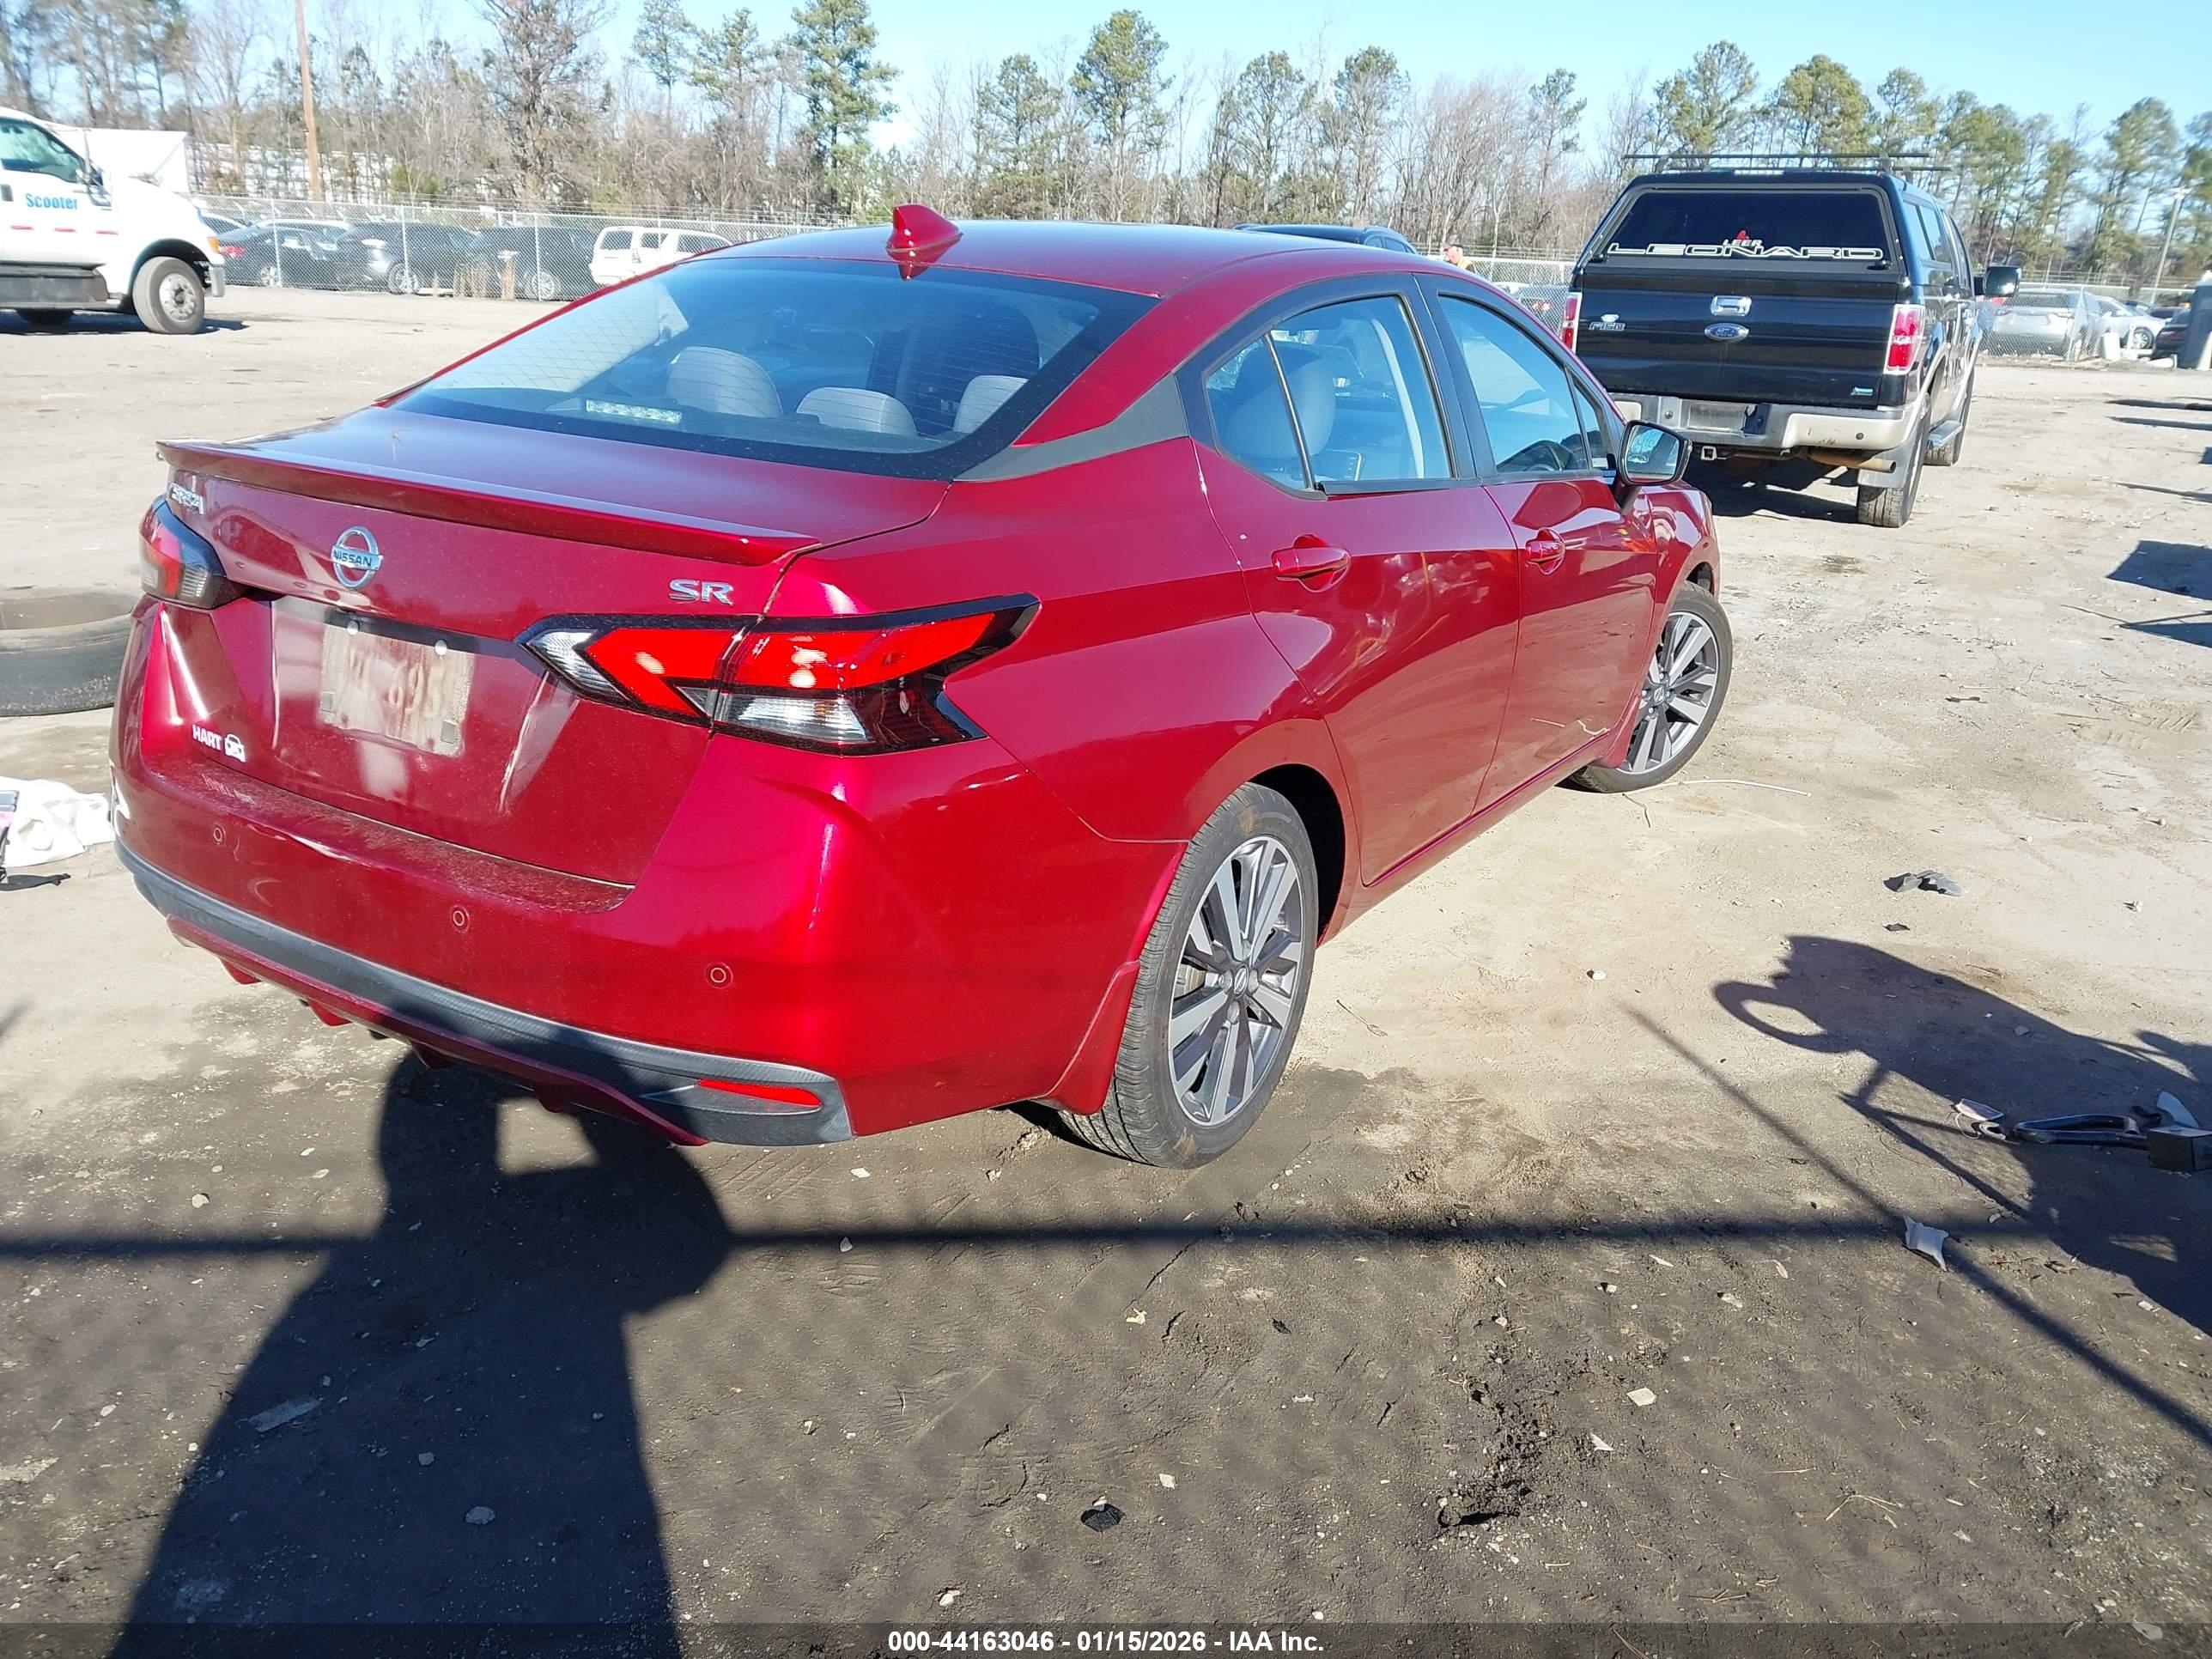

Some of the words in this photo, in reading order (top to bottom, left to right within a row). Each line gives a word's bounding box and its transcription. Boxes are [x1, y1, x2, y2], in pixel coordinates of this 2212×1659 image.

[25, 192, 77, 210] Scooter
[1607, 242, 1884, 260] LEONARD
[1723, 239, 1763, 249] LEER
[333, 550, 373, 567] NISSAN
[669, 578, 733, 605] SR
[191, 724, 222, 750] HART
